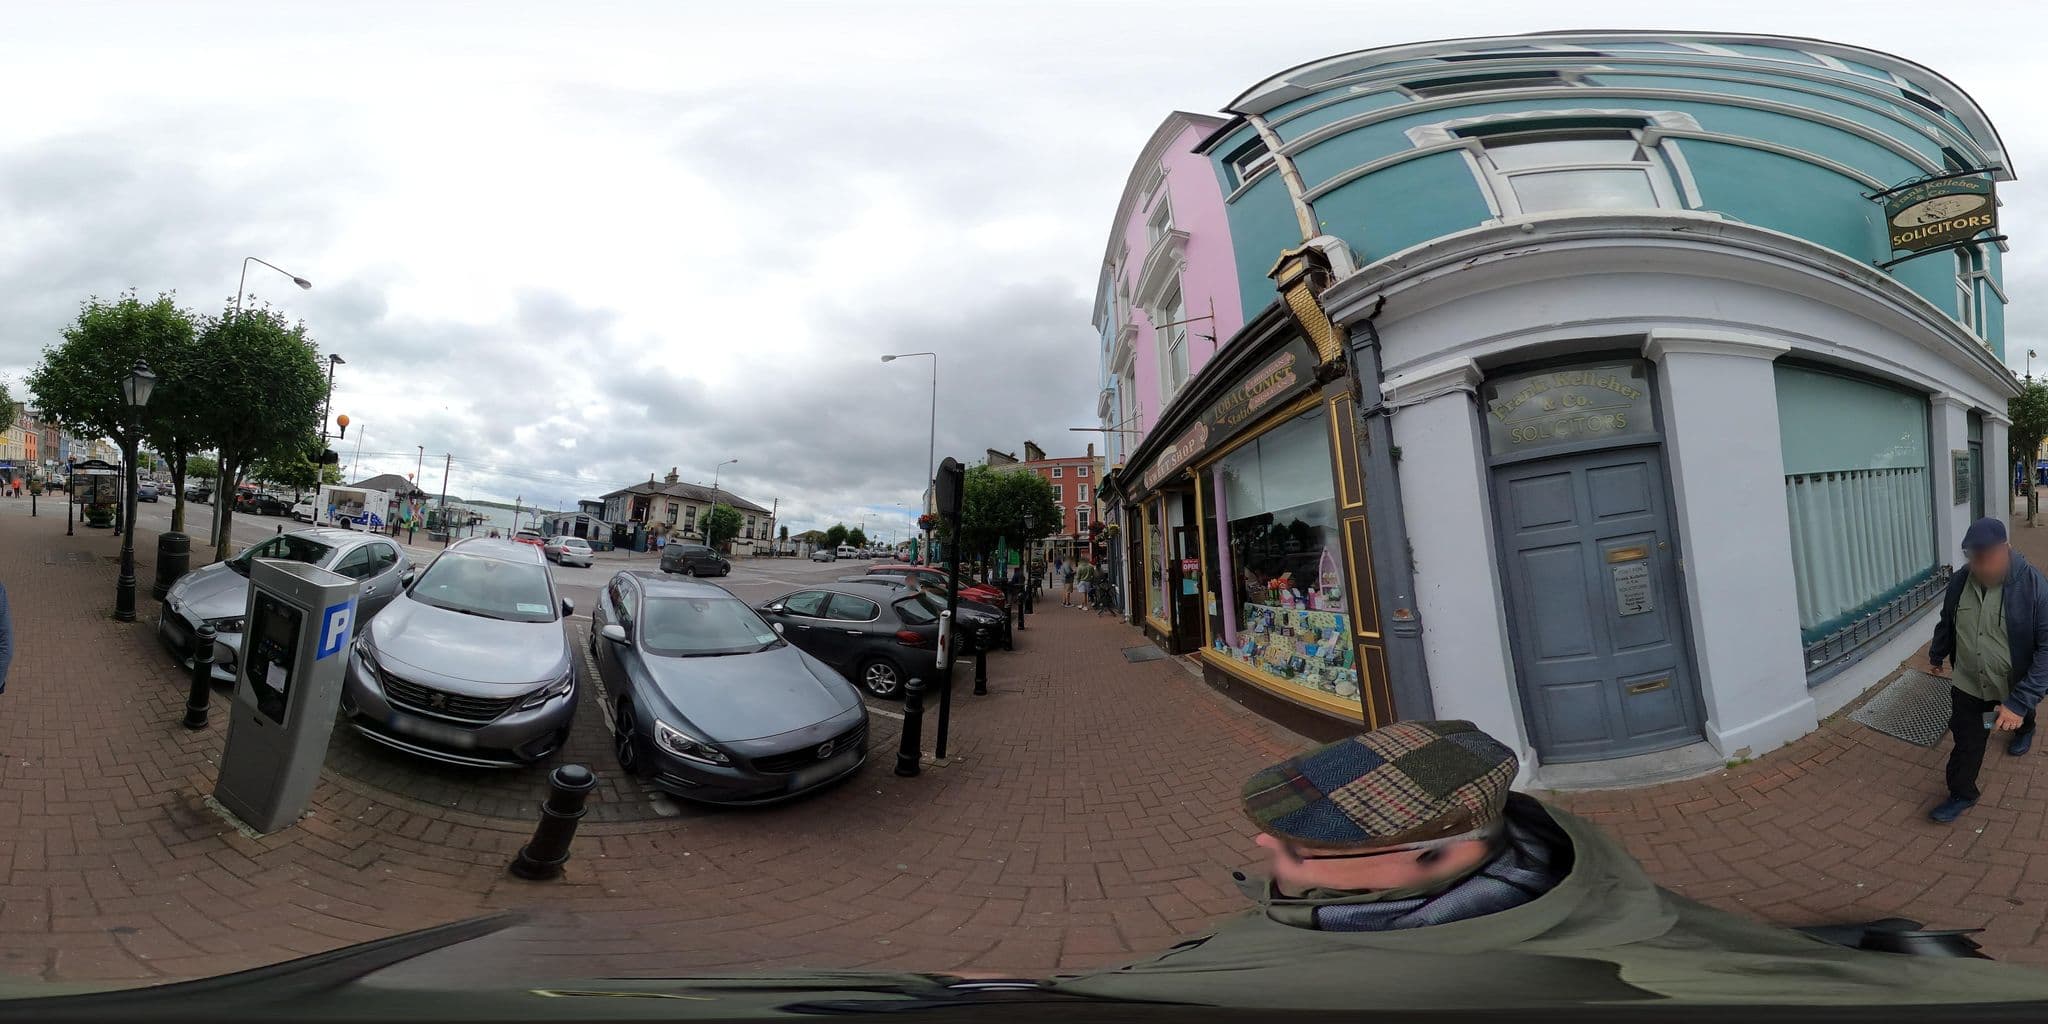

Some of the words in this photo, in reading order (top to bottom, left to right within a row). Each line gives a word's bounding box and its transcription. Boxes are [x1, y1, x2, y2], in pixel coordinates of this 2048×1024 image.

[1891, 186, 1925, 209] Frank
[1925, 179, 1980, 190] Kelleher
[1893, 214, 1991, 246] SOLICITORS
[1492, 380, 1550, 420] Frank
[1552, 371, 1641, 400] Kelleher
[1562, 393, 1593, 408] Co.
[1171, 439, 1195, 467] SHOP
[326, 608, 350, 651] P
